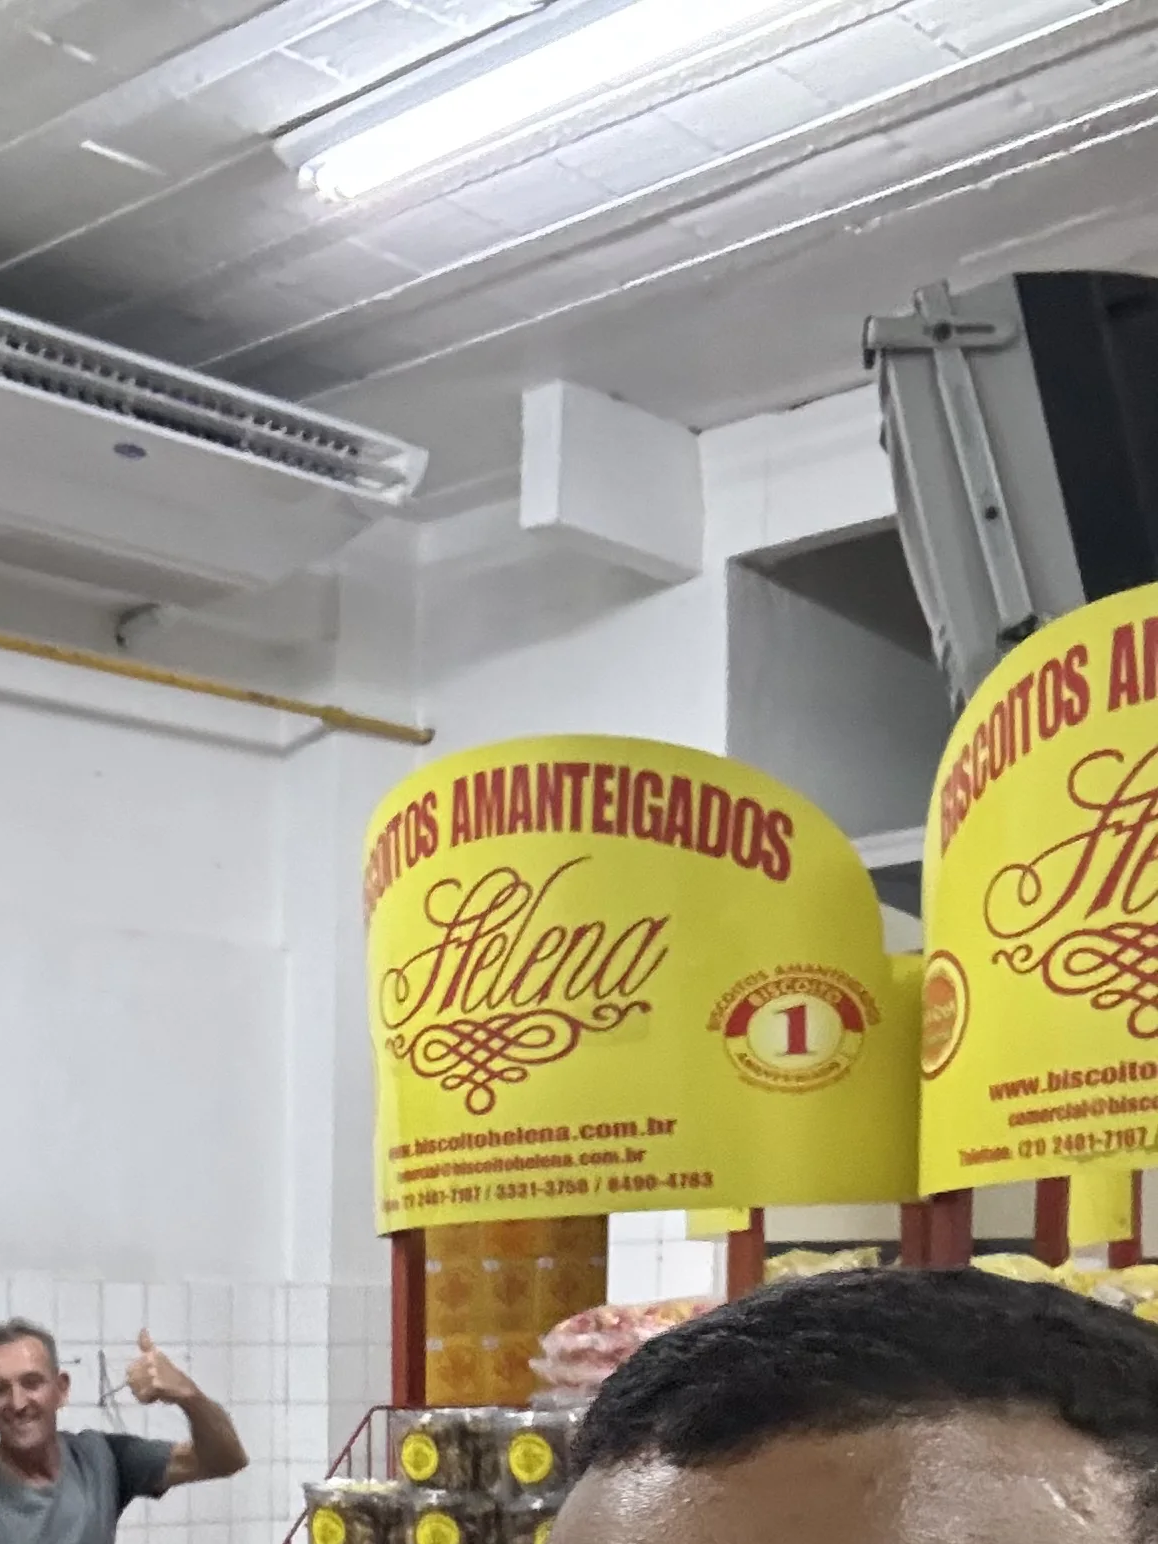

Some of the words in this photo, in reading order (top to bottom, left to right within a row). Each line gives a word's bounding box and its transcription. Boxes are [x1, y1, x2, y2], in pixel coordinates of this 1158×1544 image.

[451, 762, 794, 882] AMANTEIGADOS
[941, 644, 1090, 859] BISCOITOS
[380, 855, 671, 1029] Helena
[773, 1002, 819, 1058] 1
